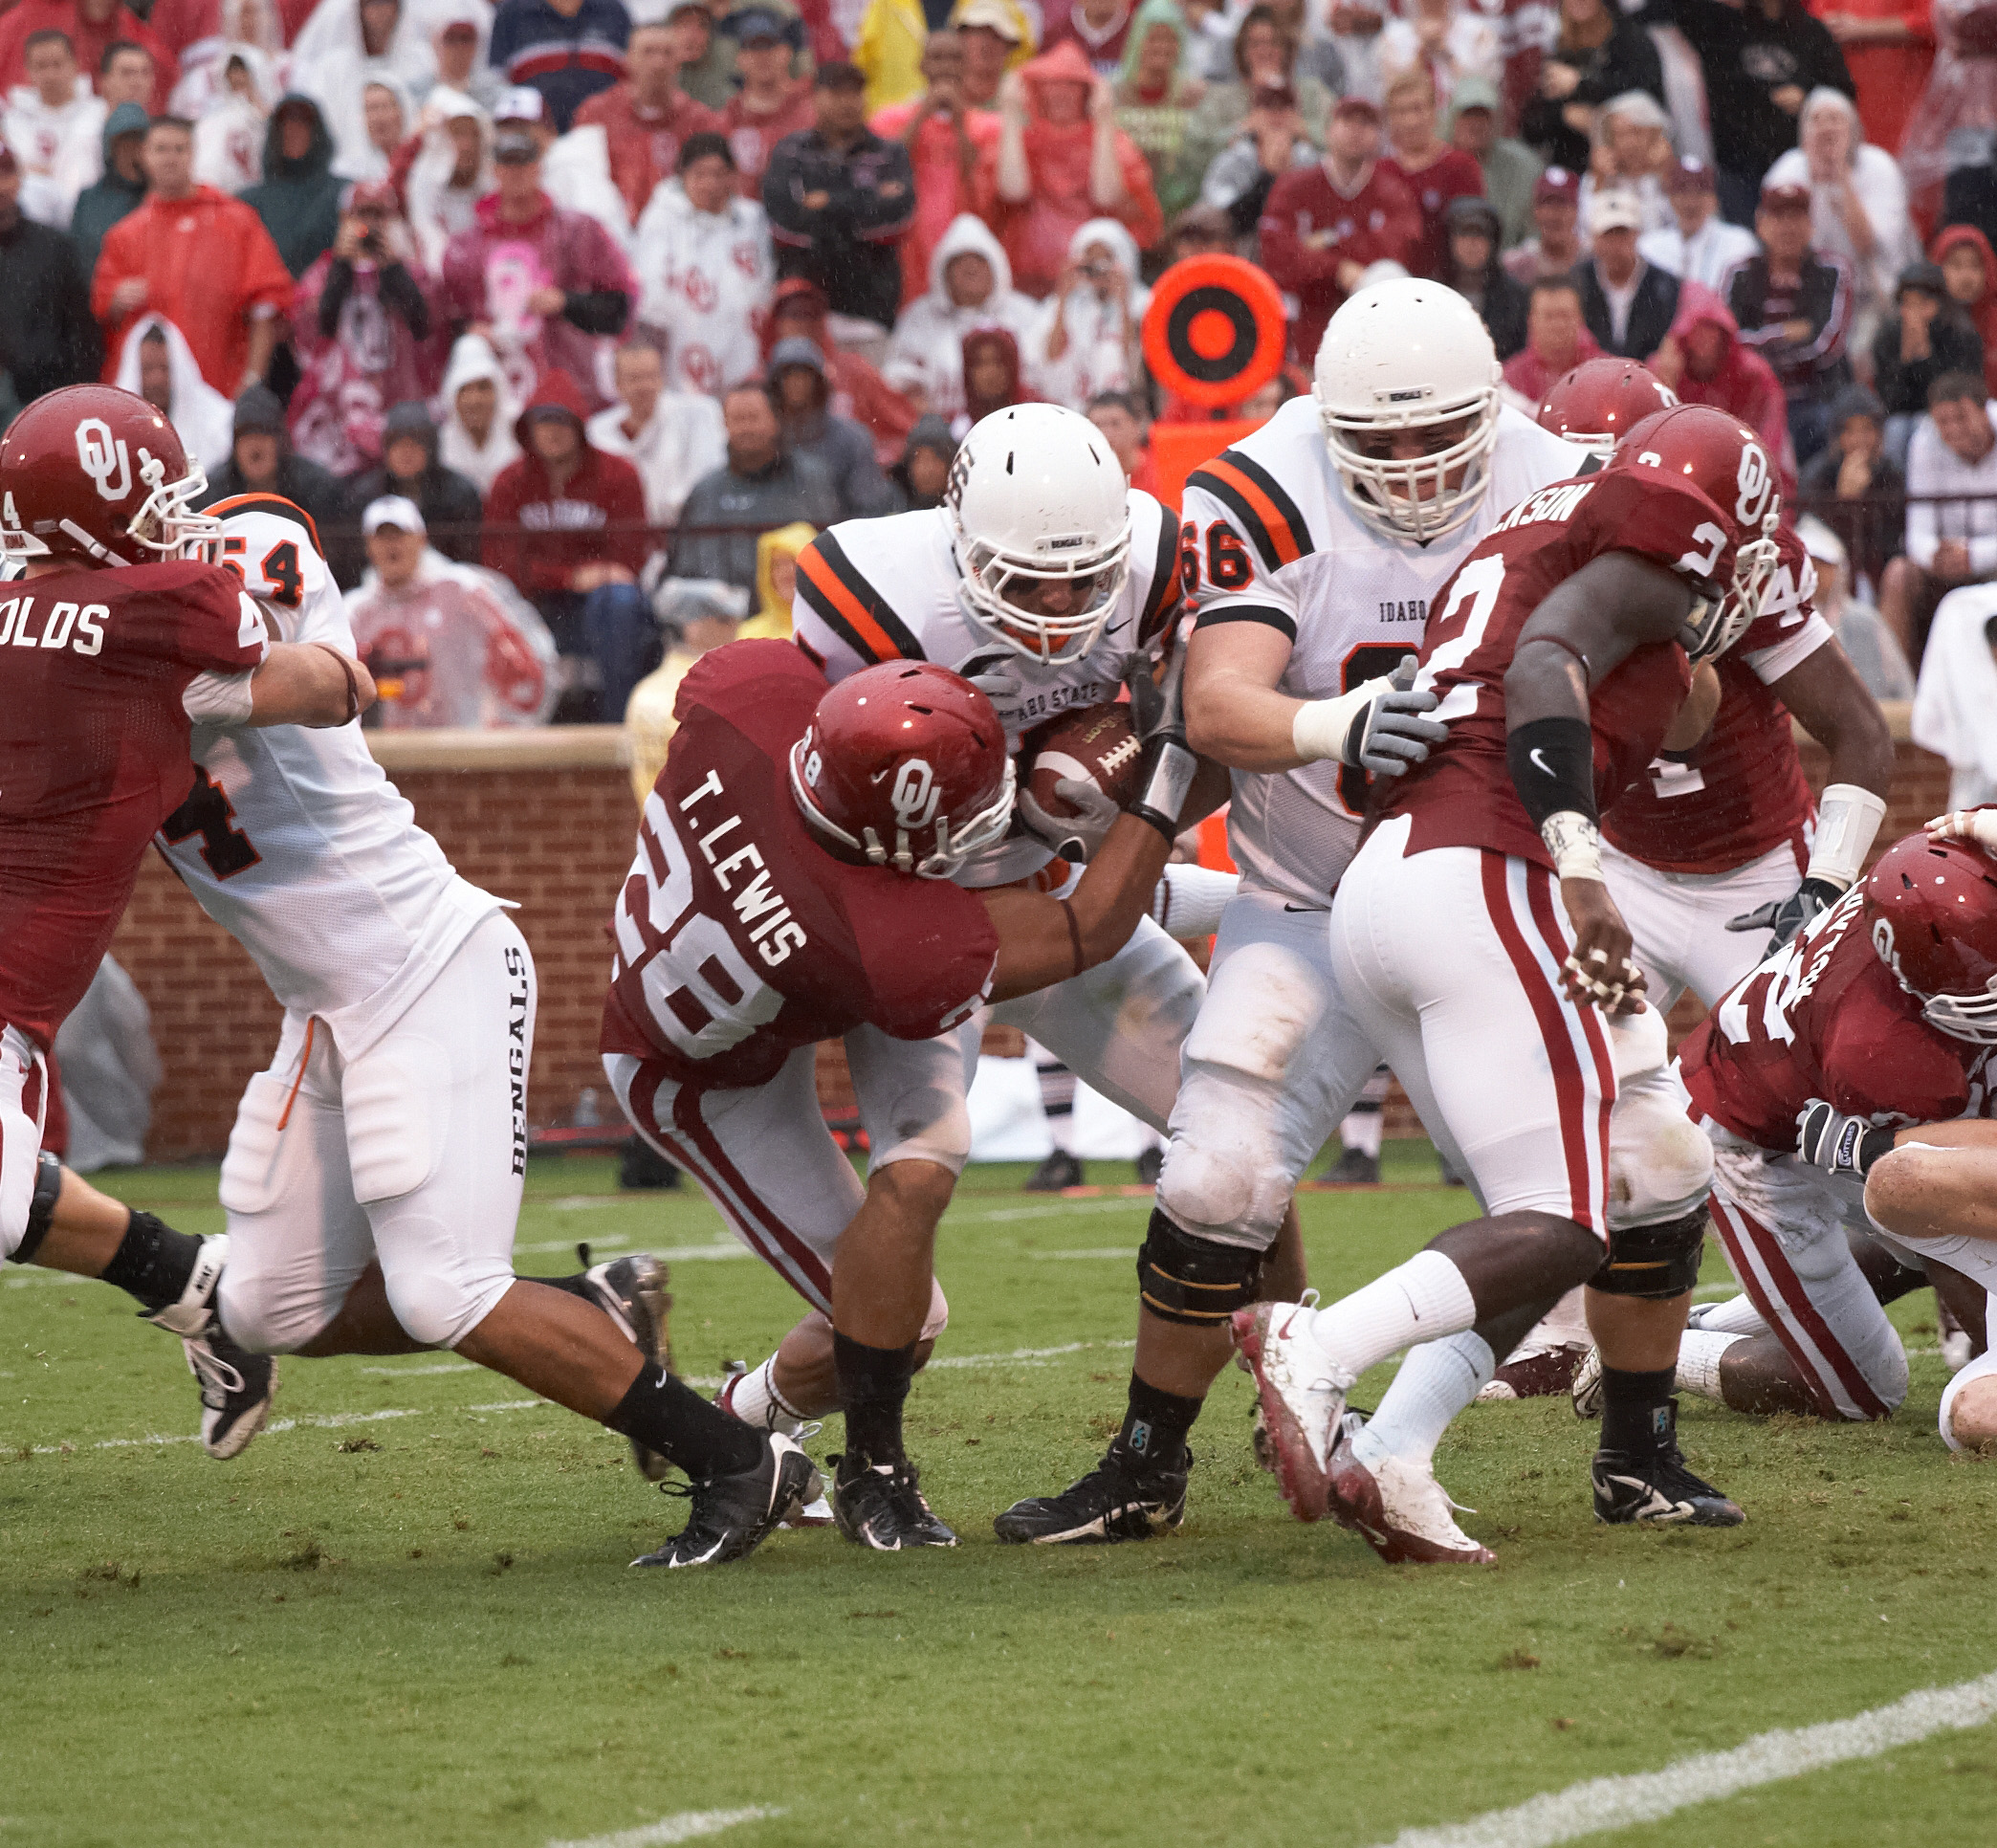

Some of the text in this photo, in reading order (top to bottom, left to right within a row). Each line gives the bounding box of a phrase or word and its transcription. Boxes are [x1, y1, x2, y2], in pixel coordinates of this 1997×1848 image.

[75, 418, 132, 501] OU
[1736, 442, 1771, 527] OU
[3, 491, 22, 530] 4
[1671, 521, 1727, 577] 2
[197, 536, 304, 608] 54
[1380, 600, 1426, 623] IDAHO
[1411, 553, 1506, 723] 2
[1051, 682, 1100, 708] STATE
[890, 759, 941, 829] OU
[679, 769, 807, 967] T.LEWIS
[612, 790, 786, 1060] 28
[504, 946, 530, 1177] BENGALS
